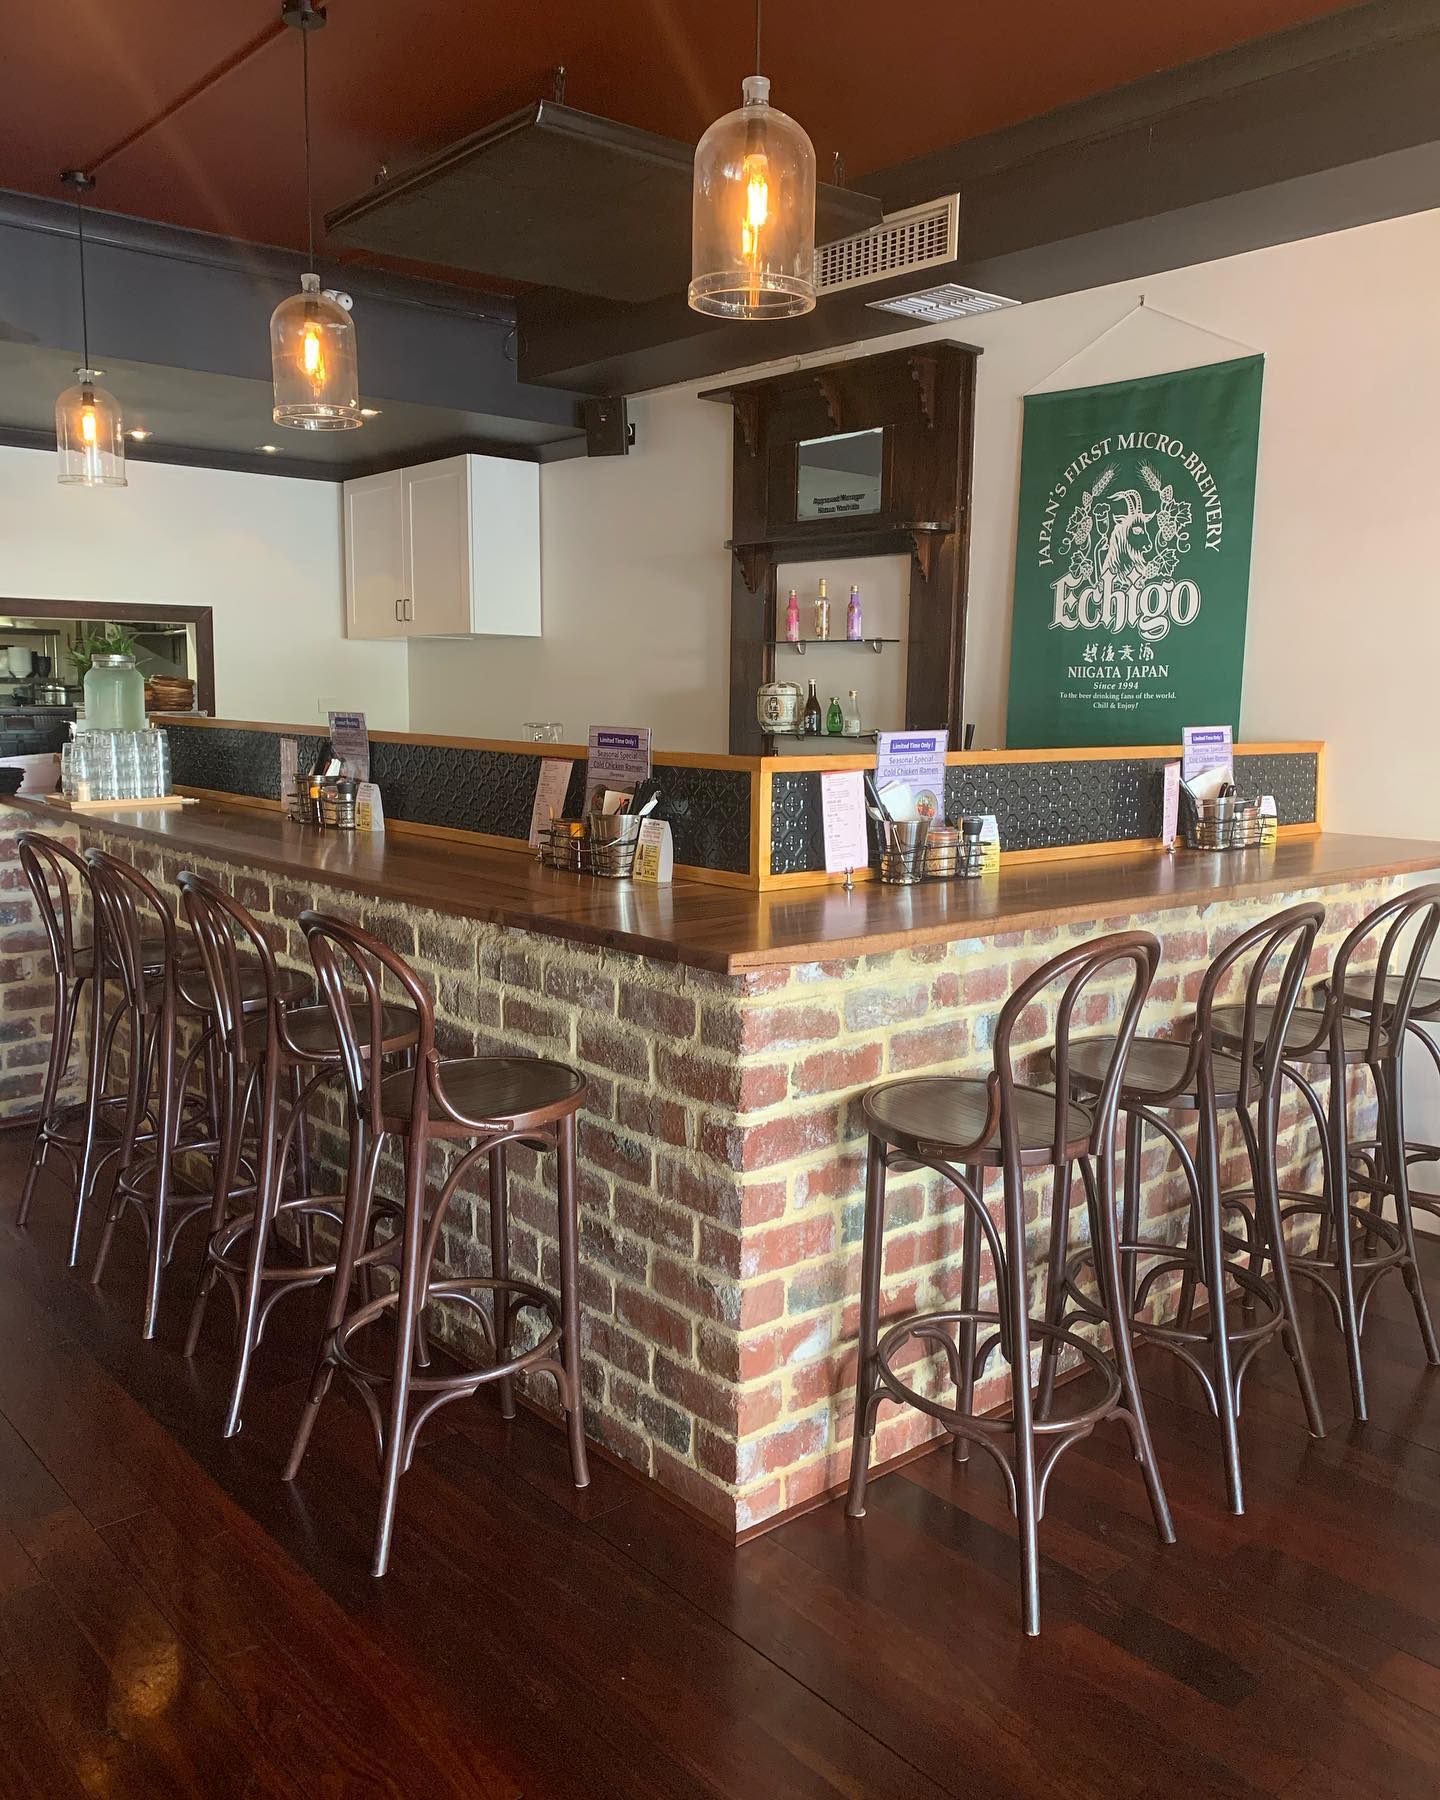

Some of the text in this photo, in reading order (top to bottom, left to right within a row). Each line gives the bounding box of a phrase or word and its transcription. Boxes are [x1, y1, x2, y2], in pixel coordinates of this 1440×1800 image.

[1039, 432, 1223, 567] JAPAN'S FIRST MICRO-BREWERY
[1048, 568, 1201, 641] Echigo
[1083, 643, 1154, 663] 越後麦酒
[1068, 665, 1169, 680] NIIGATA JAPAN
[1093, 682, 1139, 690] Since 1994
[1092, 692, 1120, 701] drinking
[1121, 692, 1134, 700] fans
[1117, 702, 1139, 711] Enjoy!
[625, 738, 634, 746] Only
[597, 750, 638, 760] Seasonal Special
[889, 755, 934, 765] Seasonal Special
[593, 760, 604, 769] Cold
[605, 761, 624, 770] Chicken
[896, 767, 919, 775] Chicken
